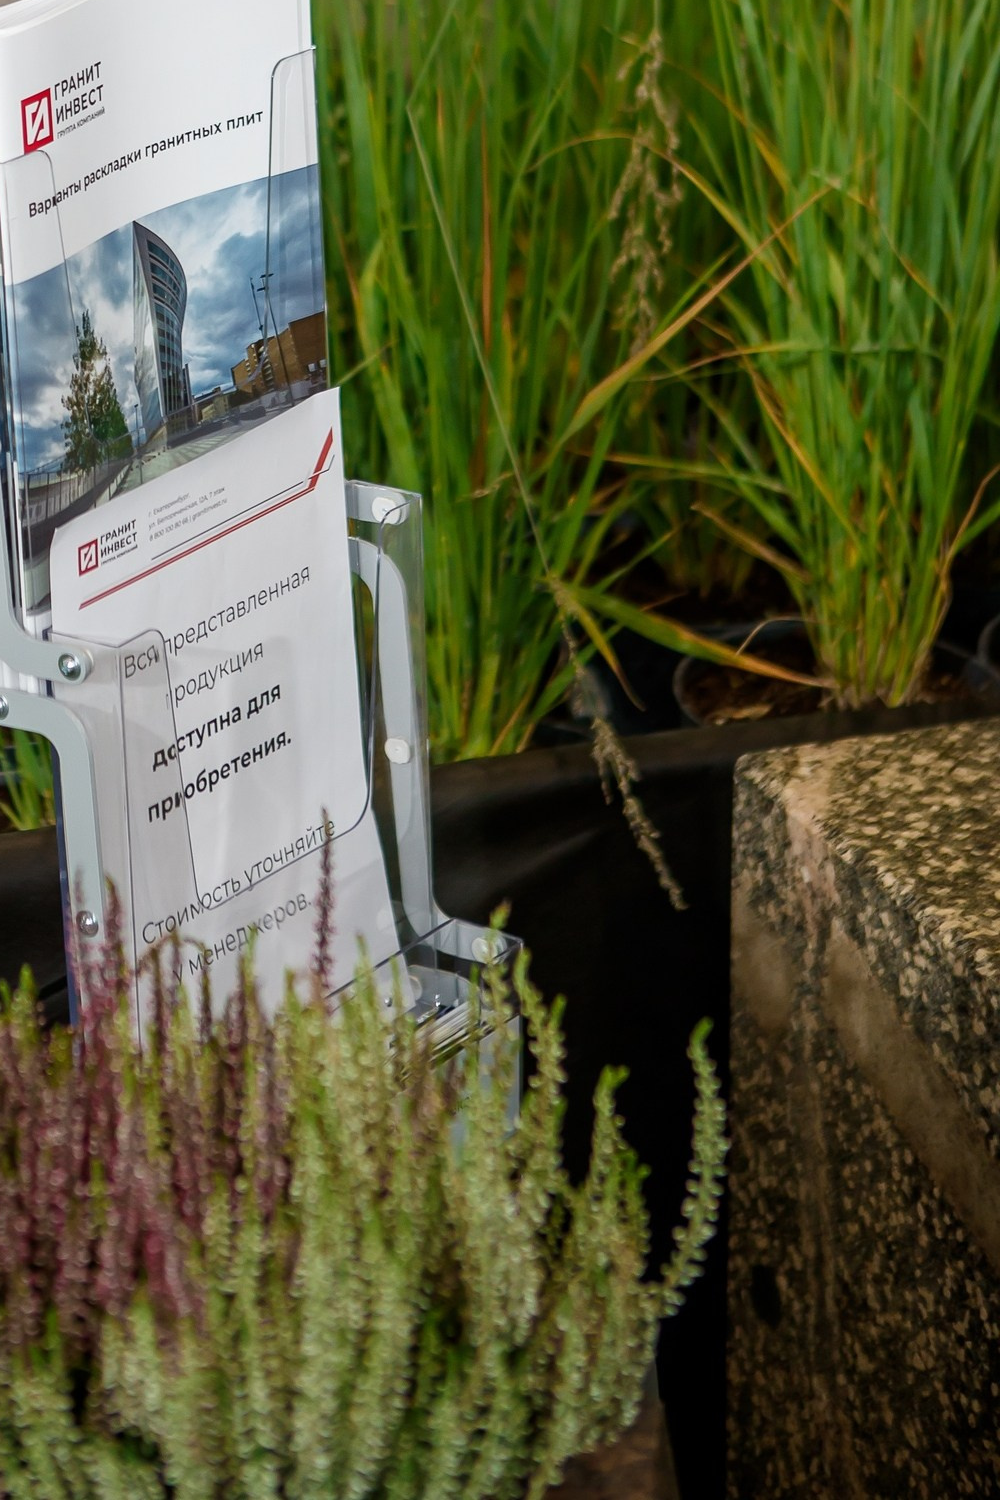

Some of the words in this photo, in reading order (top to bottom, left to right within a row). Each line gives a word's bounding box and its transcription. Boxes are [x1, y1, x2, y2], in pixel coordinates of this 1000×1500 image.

[54, 61, 101, 100] ГРАНИТ
[56, 84, 103, 124] ИНВЕСТ
[84, 149, 142, 191] раскладки
[145, 122, 222, 158] гранитных
[226, 111, 264, 131] плит
[100, 519, 136, 545] ГРАНИТ
[100, 531, 137, 558] ИНВЕСТ
[124, 645, 160, 679] Вся
[164, 566, 310, 656] представленная
[165, 642, 264, 709] родукция
[152, 706, 241, 772] доступна
[246, 684, 281, 719] для
[142, 878, 241, 945] Стоимость
[244, 820, 335, 891] уточняйте
[188, 893, 312, 976] менеджеров.
